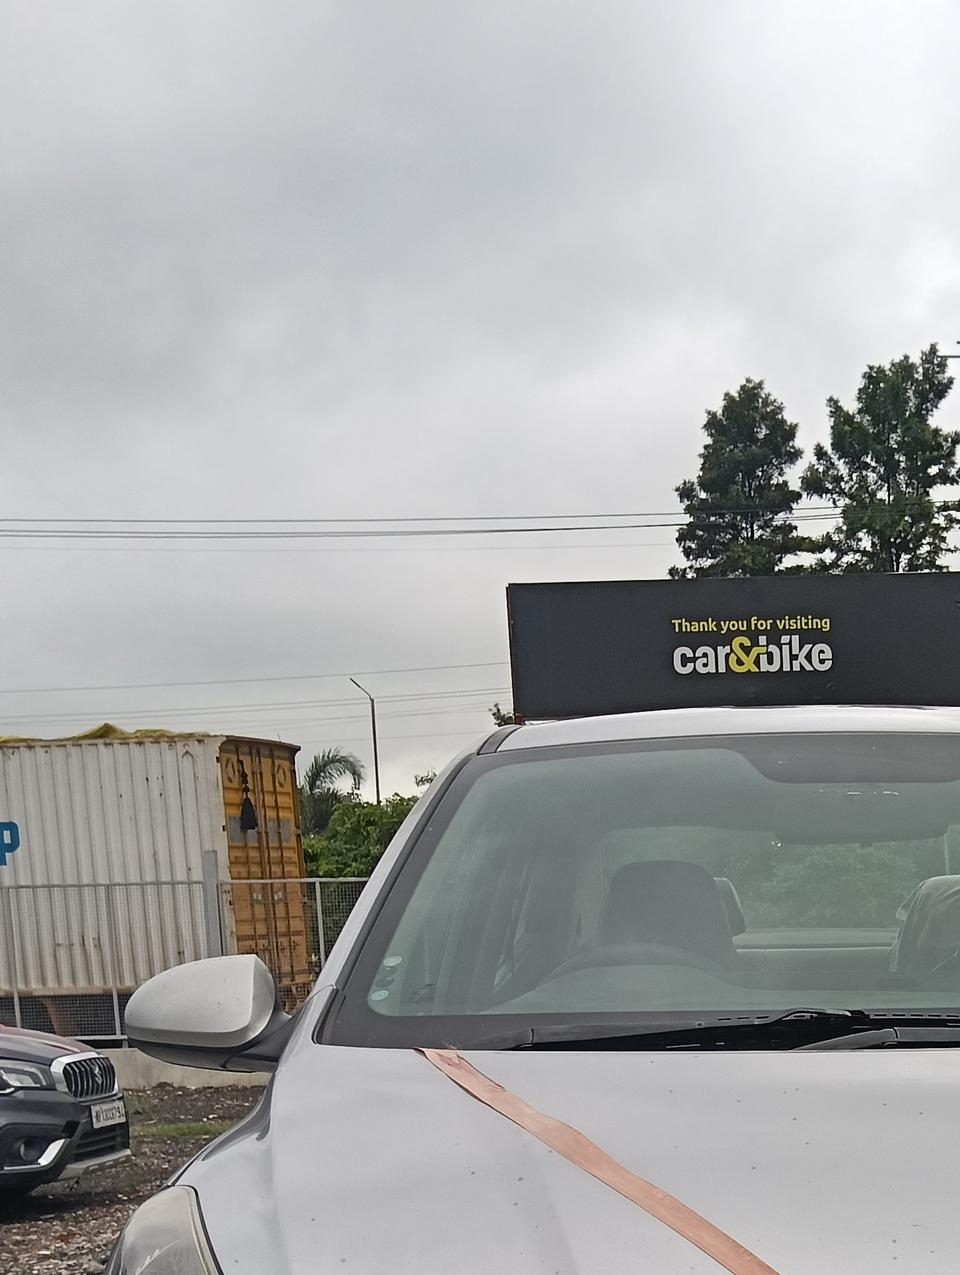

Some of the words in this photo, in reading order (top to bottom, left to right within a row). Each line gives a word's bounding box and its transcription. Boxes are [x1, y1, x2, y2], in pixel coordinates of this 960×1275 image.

[672, 617, 718, 632] Thank
[720, 619, 747, 634] you
[751, 616, 773, 631] for
[776, 615, 831, 632] visiting
[673, 634, 833, 675] car&bike
